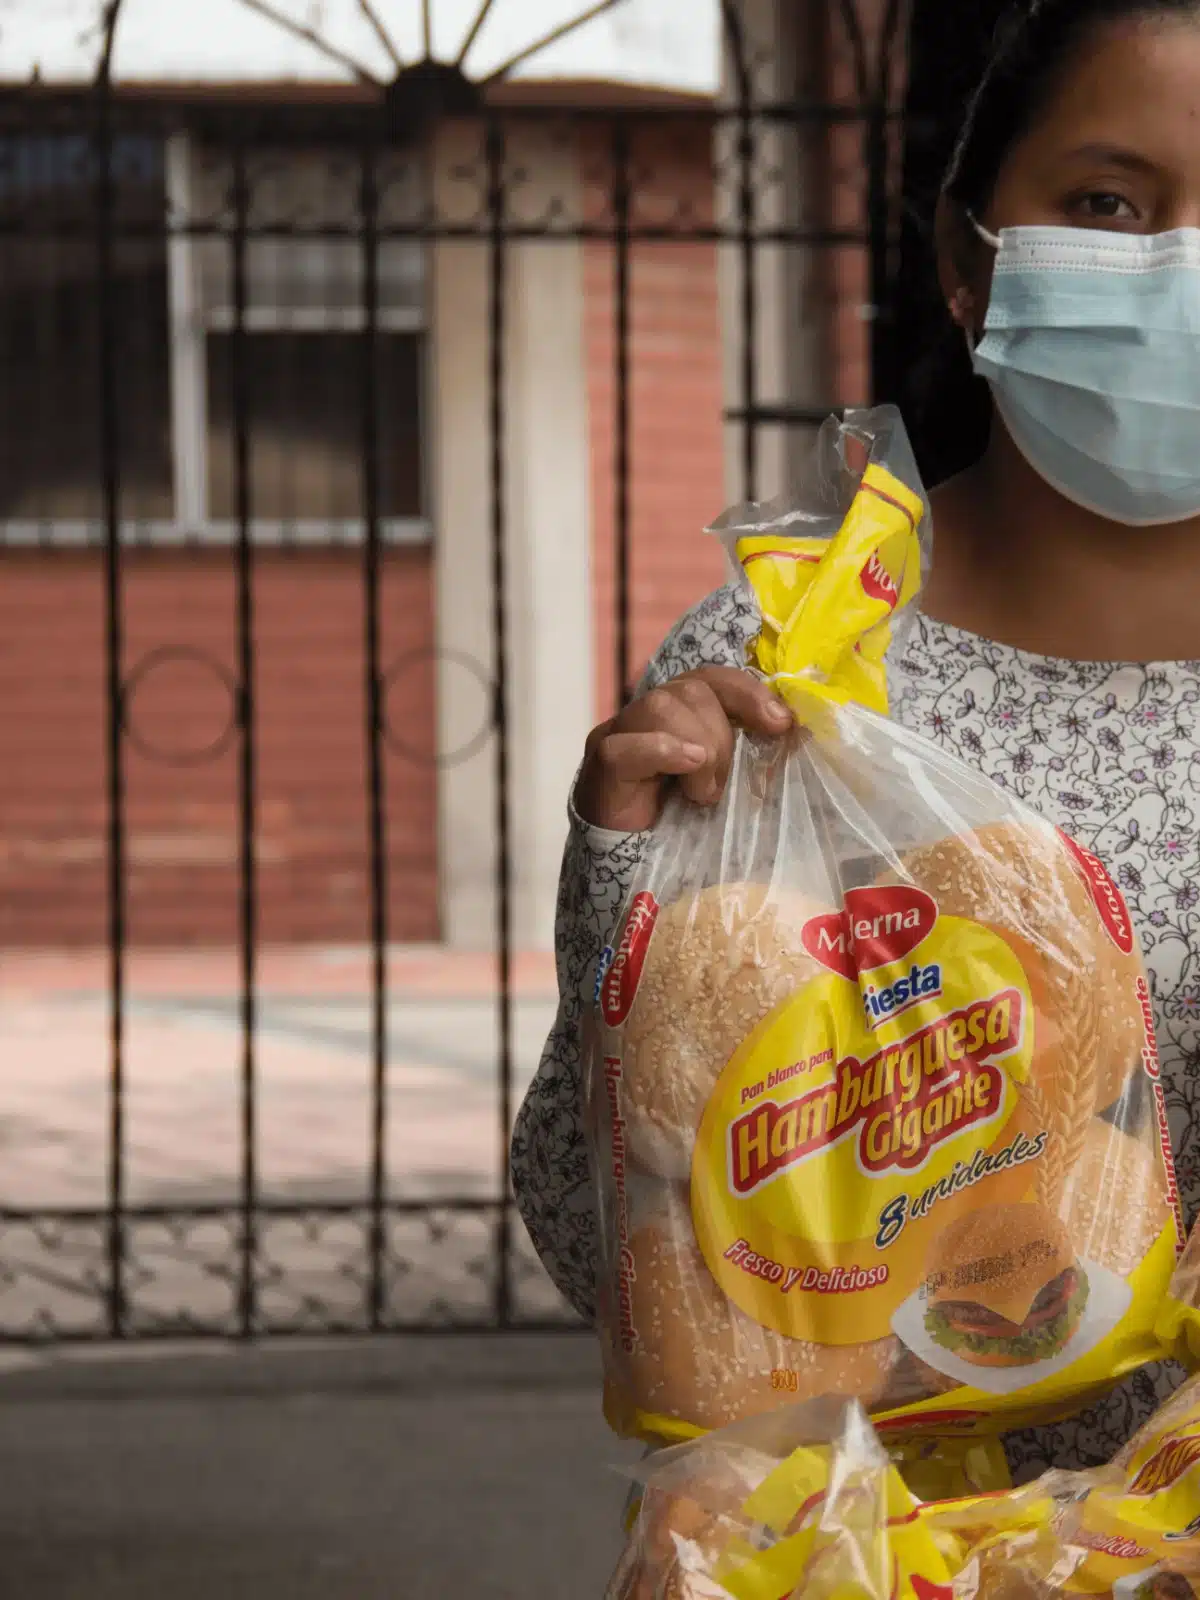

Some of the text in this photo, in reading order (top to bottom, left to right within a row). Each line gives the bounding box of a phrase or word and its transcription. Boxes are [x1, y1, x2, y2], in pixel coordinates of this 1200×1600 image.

[816, 906, 921, 954] Merna
[1081, 850, 1129, 939] Moder
[736, 996, 1014, 1184] Hamburguesa
[740, 1048, 834, 1105] Pan blanco para
[864, 1070, 993, 1162] Gigante
[874, 1131, 1048, 1249] 8 unidades
[725, 1239, 781, 1281] Fresco
[782, 1265, 800, 1292] y
[800, 1264, 888, 1293] Delicioso
